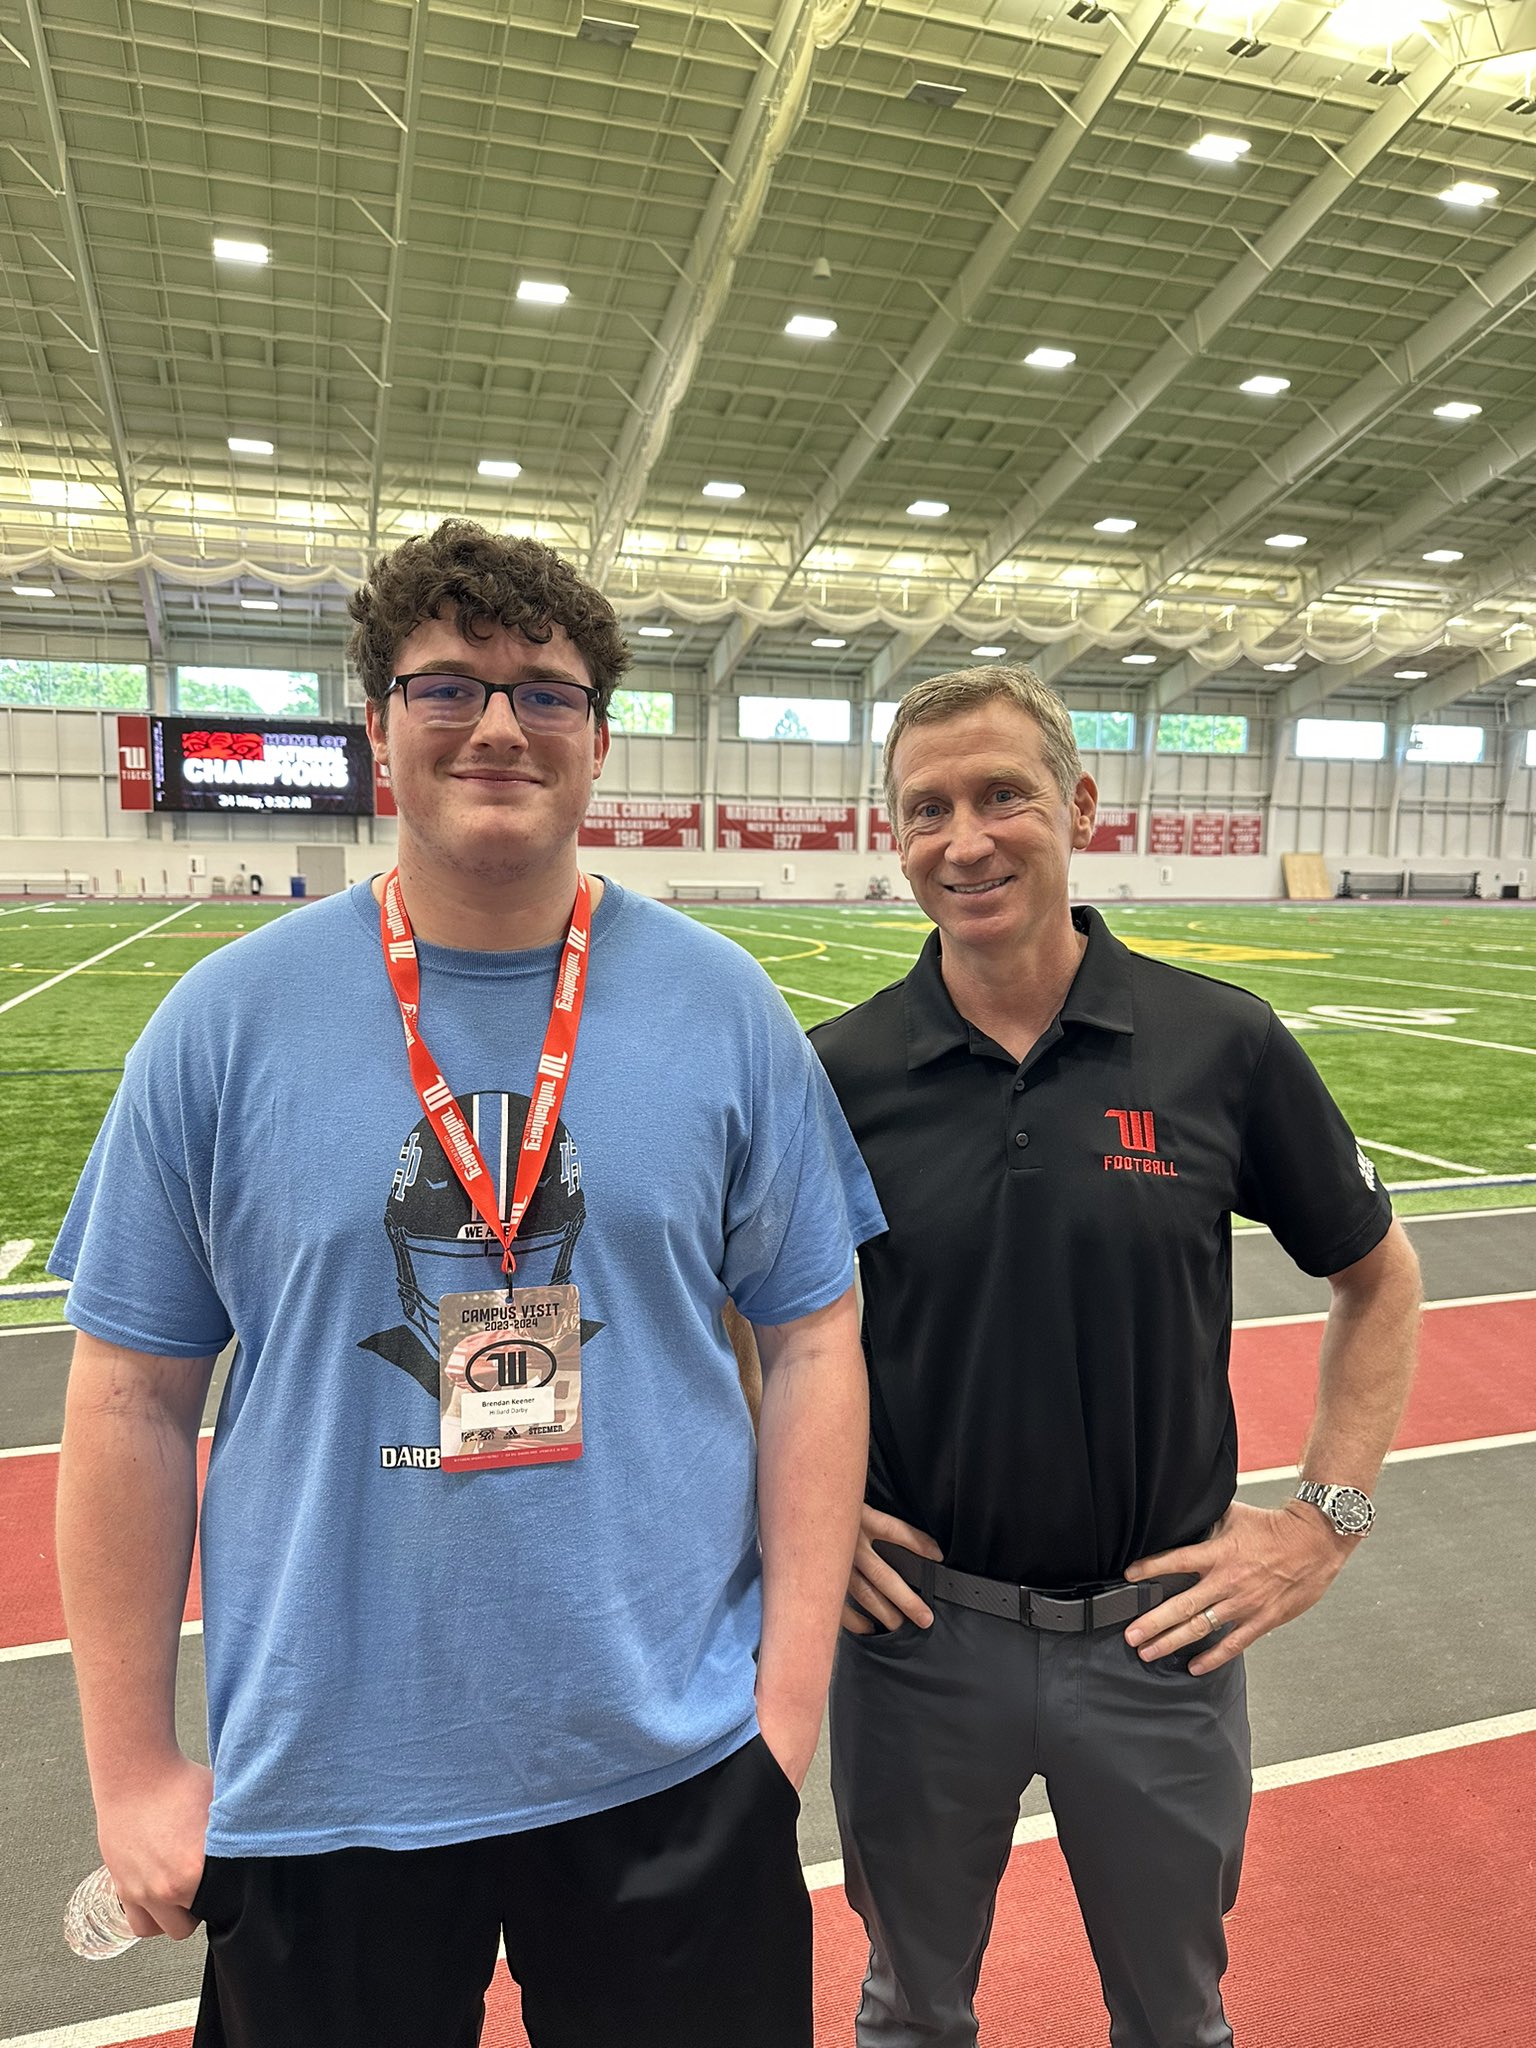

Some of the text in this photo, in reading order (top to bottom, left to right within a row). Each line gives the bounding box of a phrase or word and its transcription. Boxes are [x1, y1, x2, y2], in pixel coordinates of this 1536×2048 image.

[121, 770, 152, 780] TIGERS
[183, 757, 349, 788] CHAMPIONS
[621, 803, 693, 819] CHAMPIONS
[726, 806, 848, 822] NATIONAL CHAMPIONS
[1103, 1154, 1179, 1177] FOOTBALL
[465, 1226, 511, 1238] WE AE
[462, 1303, 560, 1324] CAMPUS VISIT
[484, 1318, 538, 1331] 2023-2024
[482, 1397, 535, 1408] Brendan Keener
[511, 1406, 528, 1415] Darby
[381, 1445, 440, 1468] DARB
